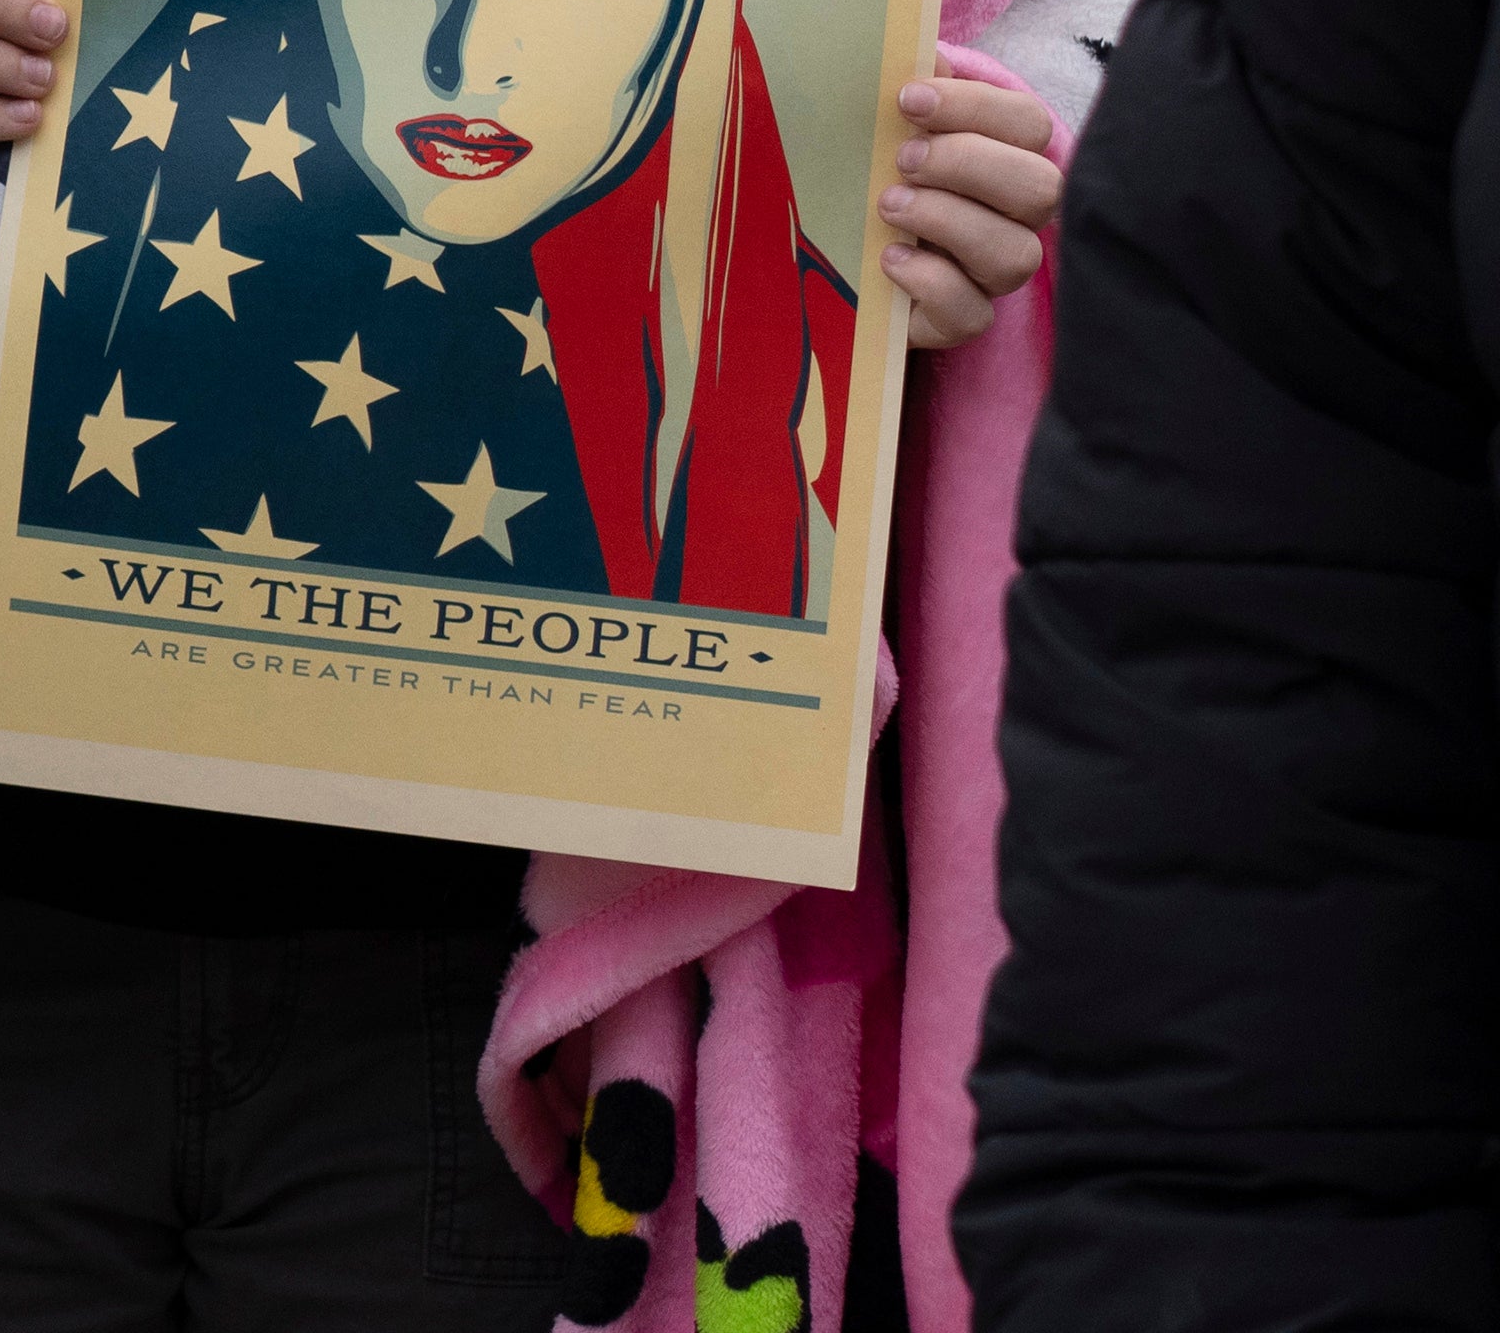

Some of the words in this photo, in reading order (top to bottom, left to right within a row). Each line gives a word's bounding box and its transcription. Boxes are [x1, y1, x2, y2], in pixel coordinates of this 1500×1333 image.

[98, 557, 225, 613] WE
[249, 576, 403, 635] THE
[430, 598, 730, 674] PEOPLE
[130, 639, 208, 665] ARE
[232, 651, 420, 691] GREATER
[442, 675, 553, 706] THAN
[578, 691, 683, 721] FEAR
